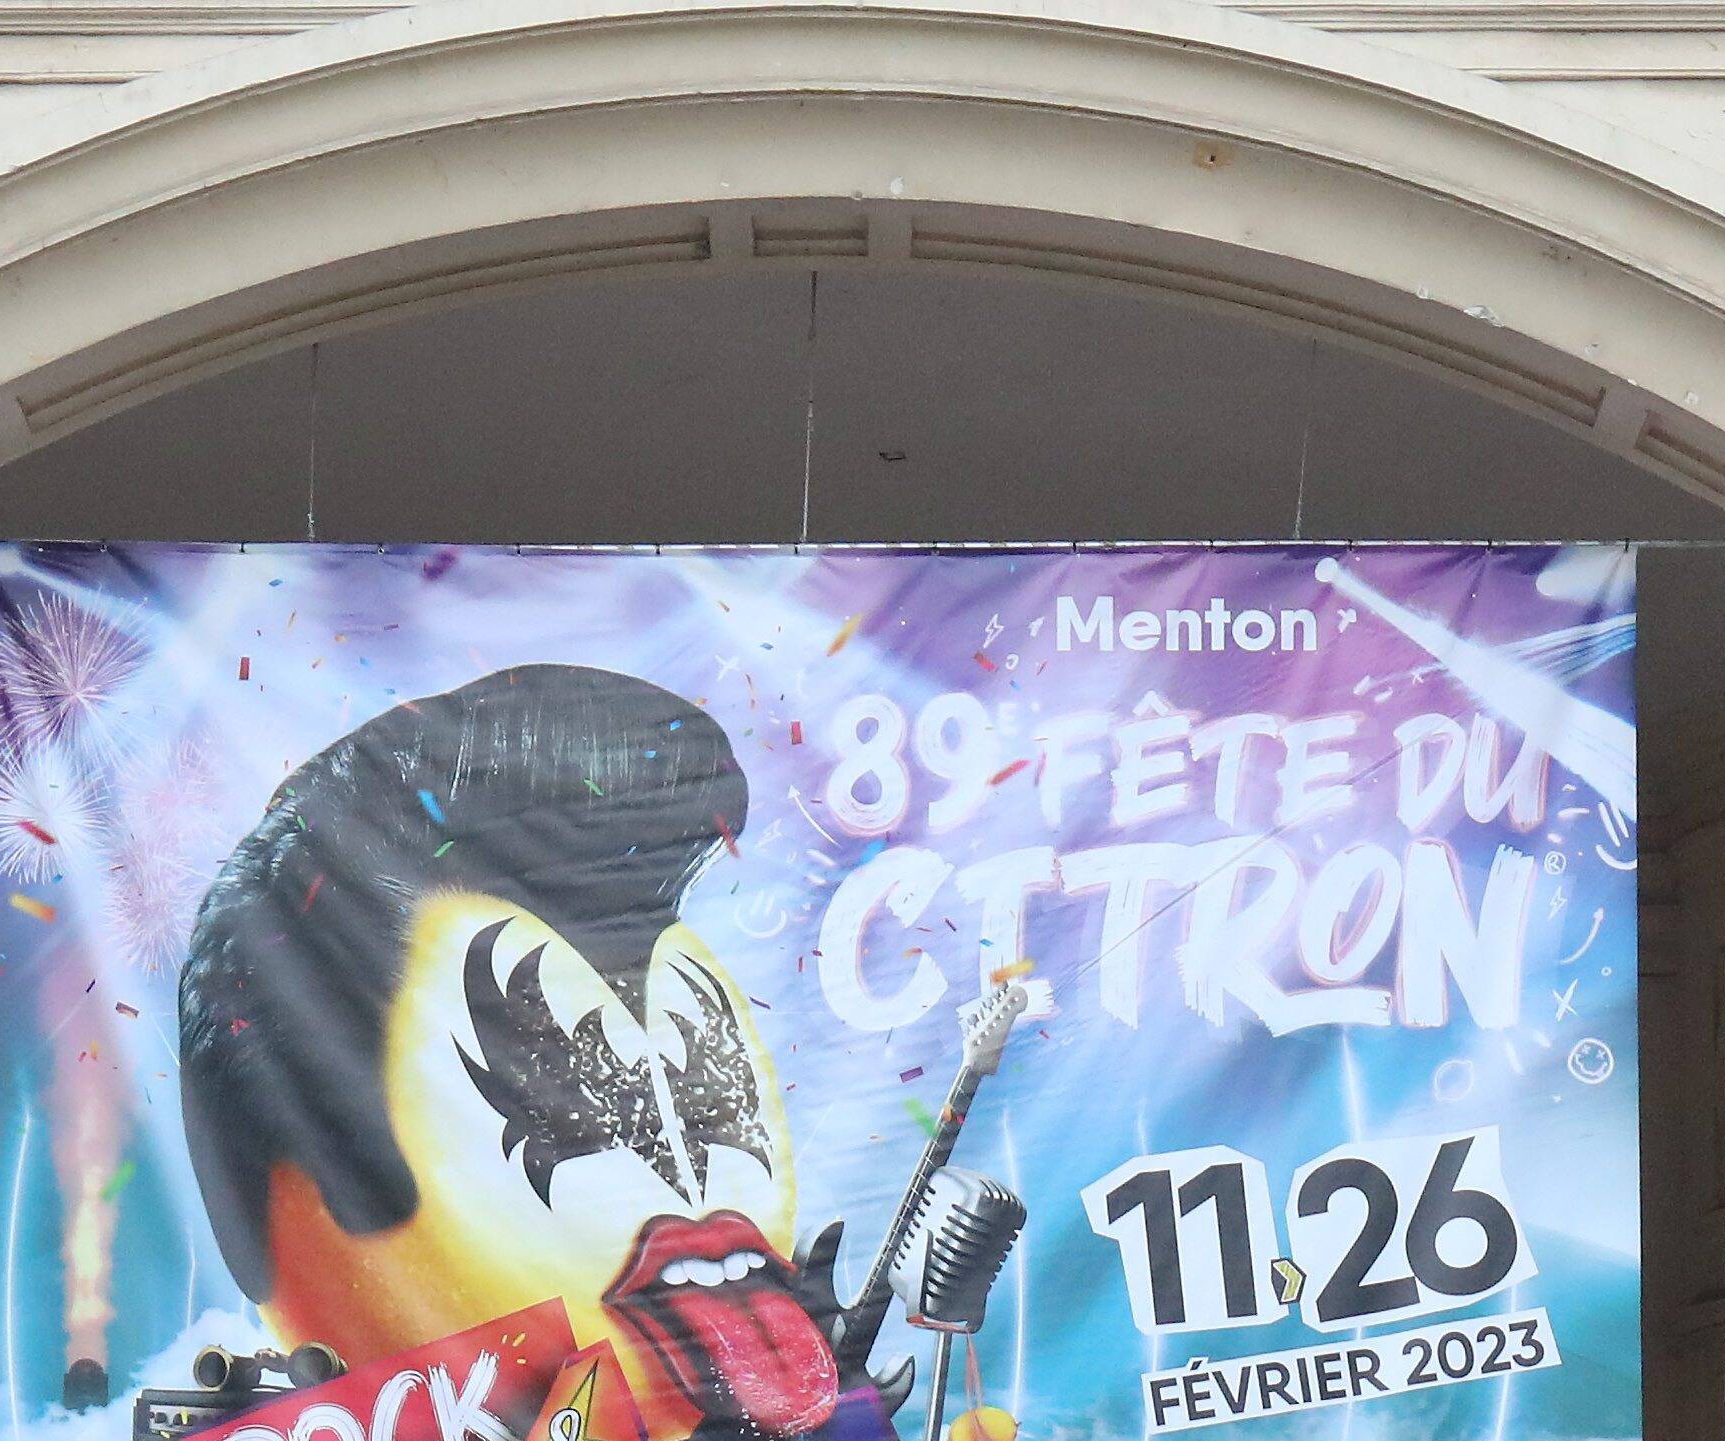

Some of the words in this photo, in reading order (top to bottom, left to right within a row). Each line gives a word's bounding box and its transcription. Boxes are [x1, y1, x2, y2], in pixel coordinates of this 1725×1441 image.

[1057, 596, 1317, 651] Menton
[1035, 690, 1360, 827] FÊTE
[1395, 711, 1551, 827] DU
[817, 836, 1536, 1036] CITRON
[1106, 1163, 1257, 1325] 11
[1298, 1136, 1517, 1322] 26
[1150, 1349, 1389, 1426] FÉVRIER
[1402, 1319, 1545, 1385] 2023
